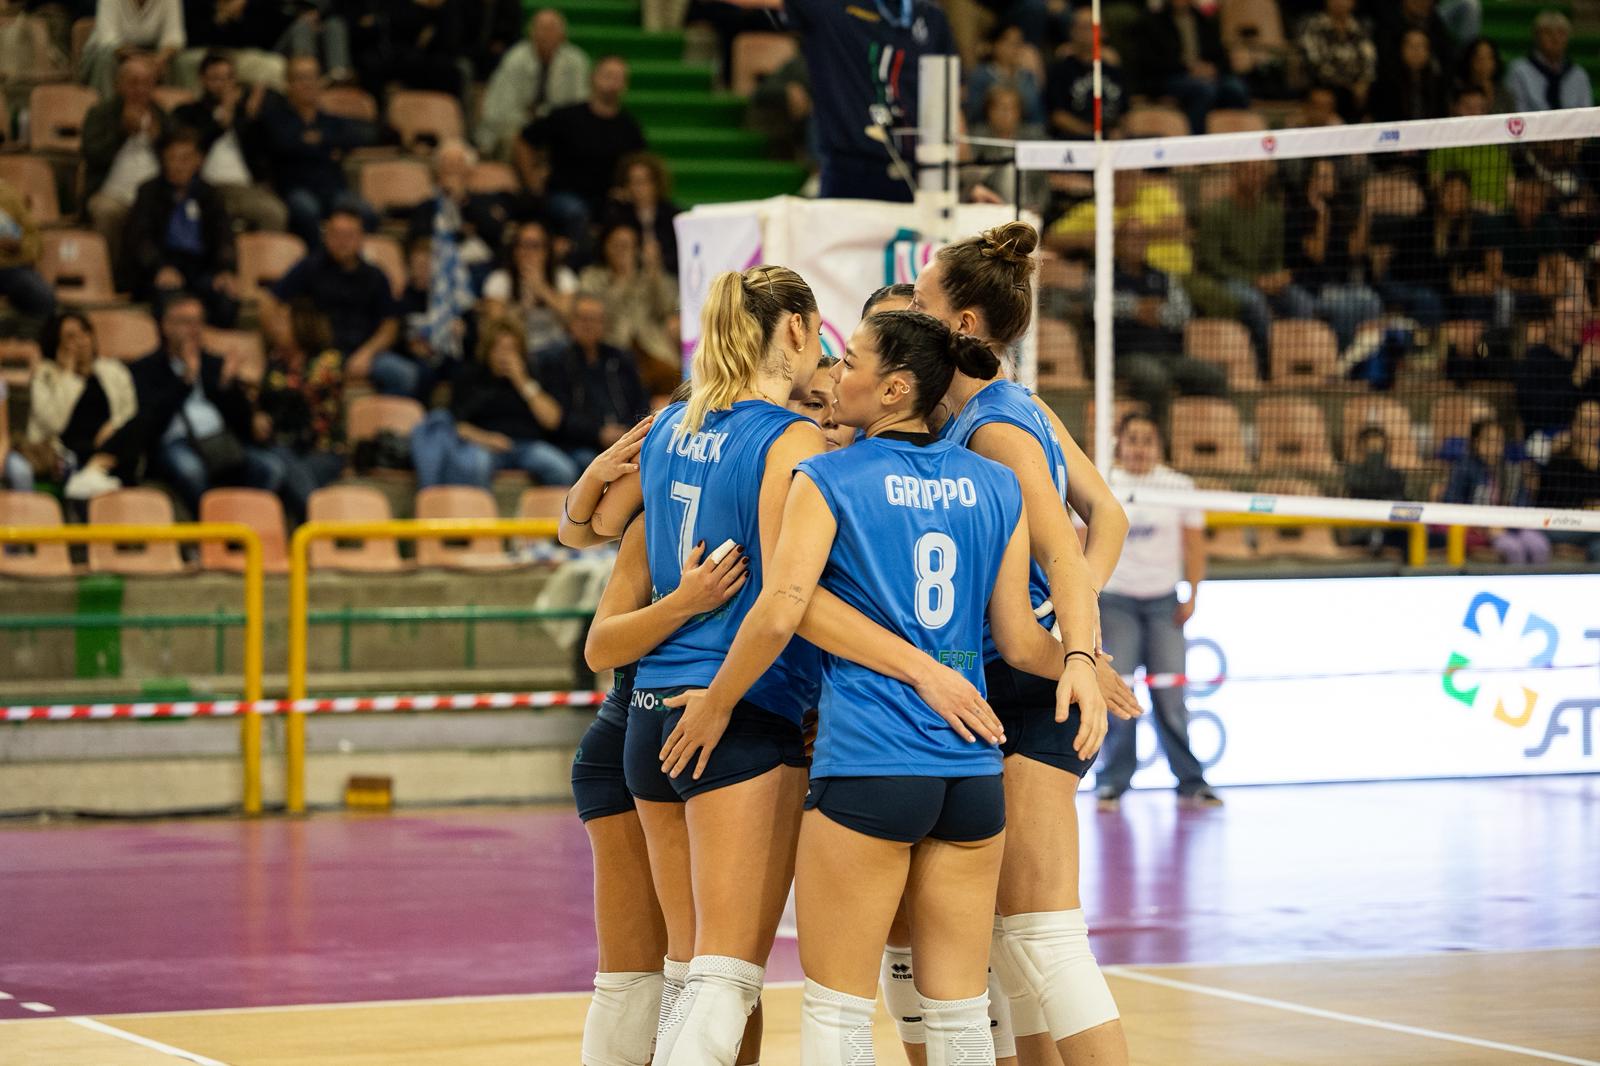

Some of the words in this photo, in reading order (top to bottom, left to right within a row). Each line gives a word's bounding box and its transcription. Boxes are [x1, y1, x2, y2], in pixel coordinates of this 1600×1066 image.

[670, 480, 702, 576] 7
[884, 474, 977, 510] GRIPPO
[914, 532, 957, 630] 8
